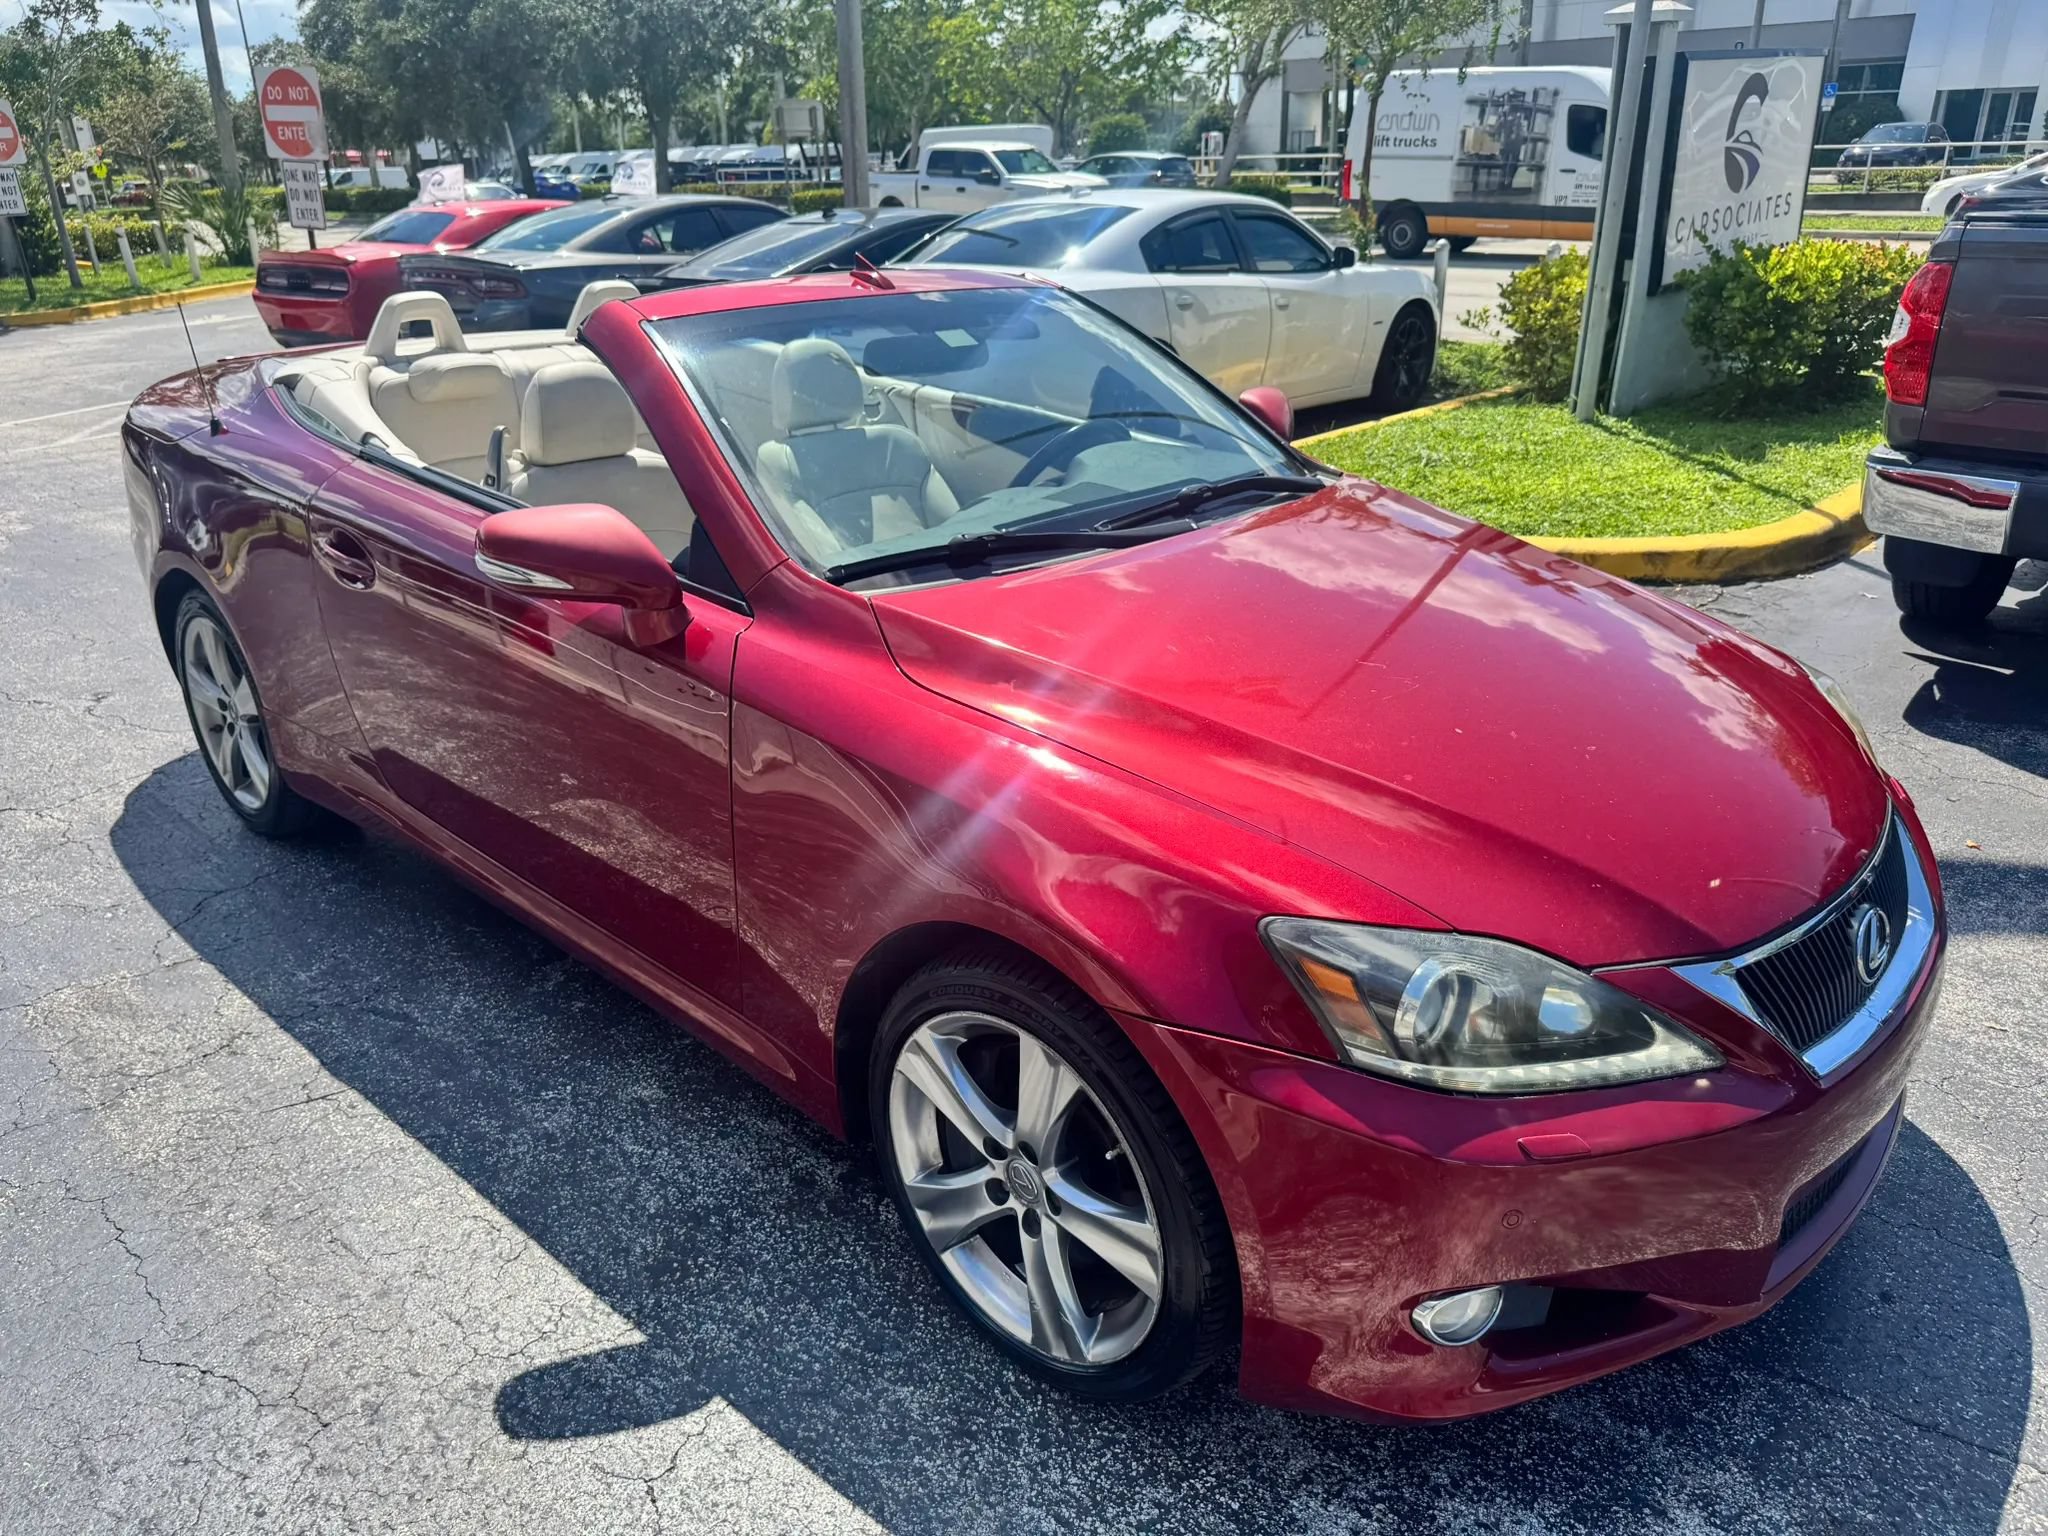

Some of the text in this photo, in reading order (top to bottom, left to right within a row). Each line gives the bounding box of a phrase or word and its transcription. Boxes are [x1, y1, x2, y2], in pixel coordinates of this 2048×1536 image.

[266, 85, 310, 101] DO NOT
[277, 126, 306, 141] ENTE
[1373, 135, 1437, 147] lift trucks
[302, 170, 317, 183] WAY
[1, 186, 17, 196] NOT
[290, 188, 319, 203] DO NOT
[0, 199, 18, 210] NTER
[296, 208, 320, 221] ENTER
[1675, 192, 1792, 243] CARSOCIATES
